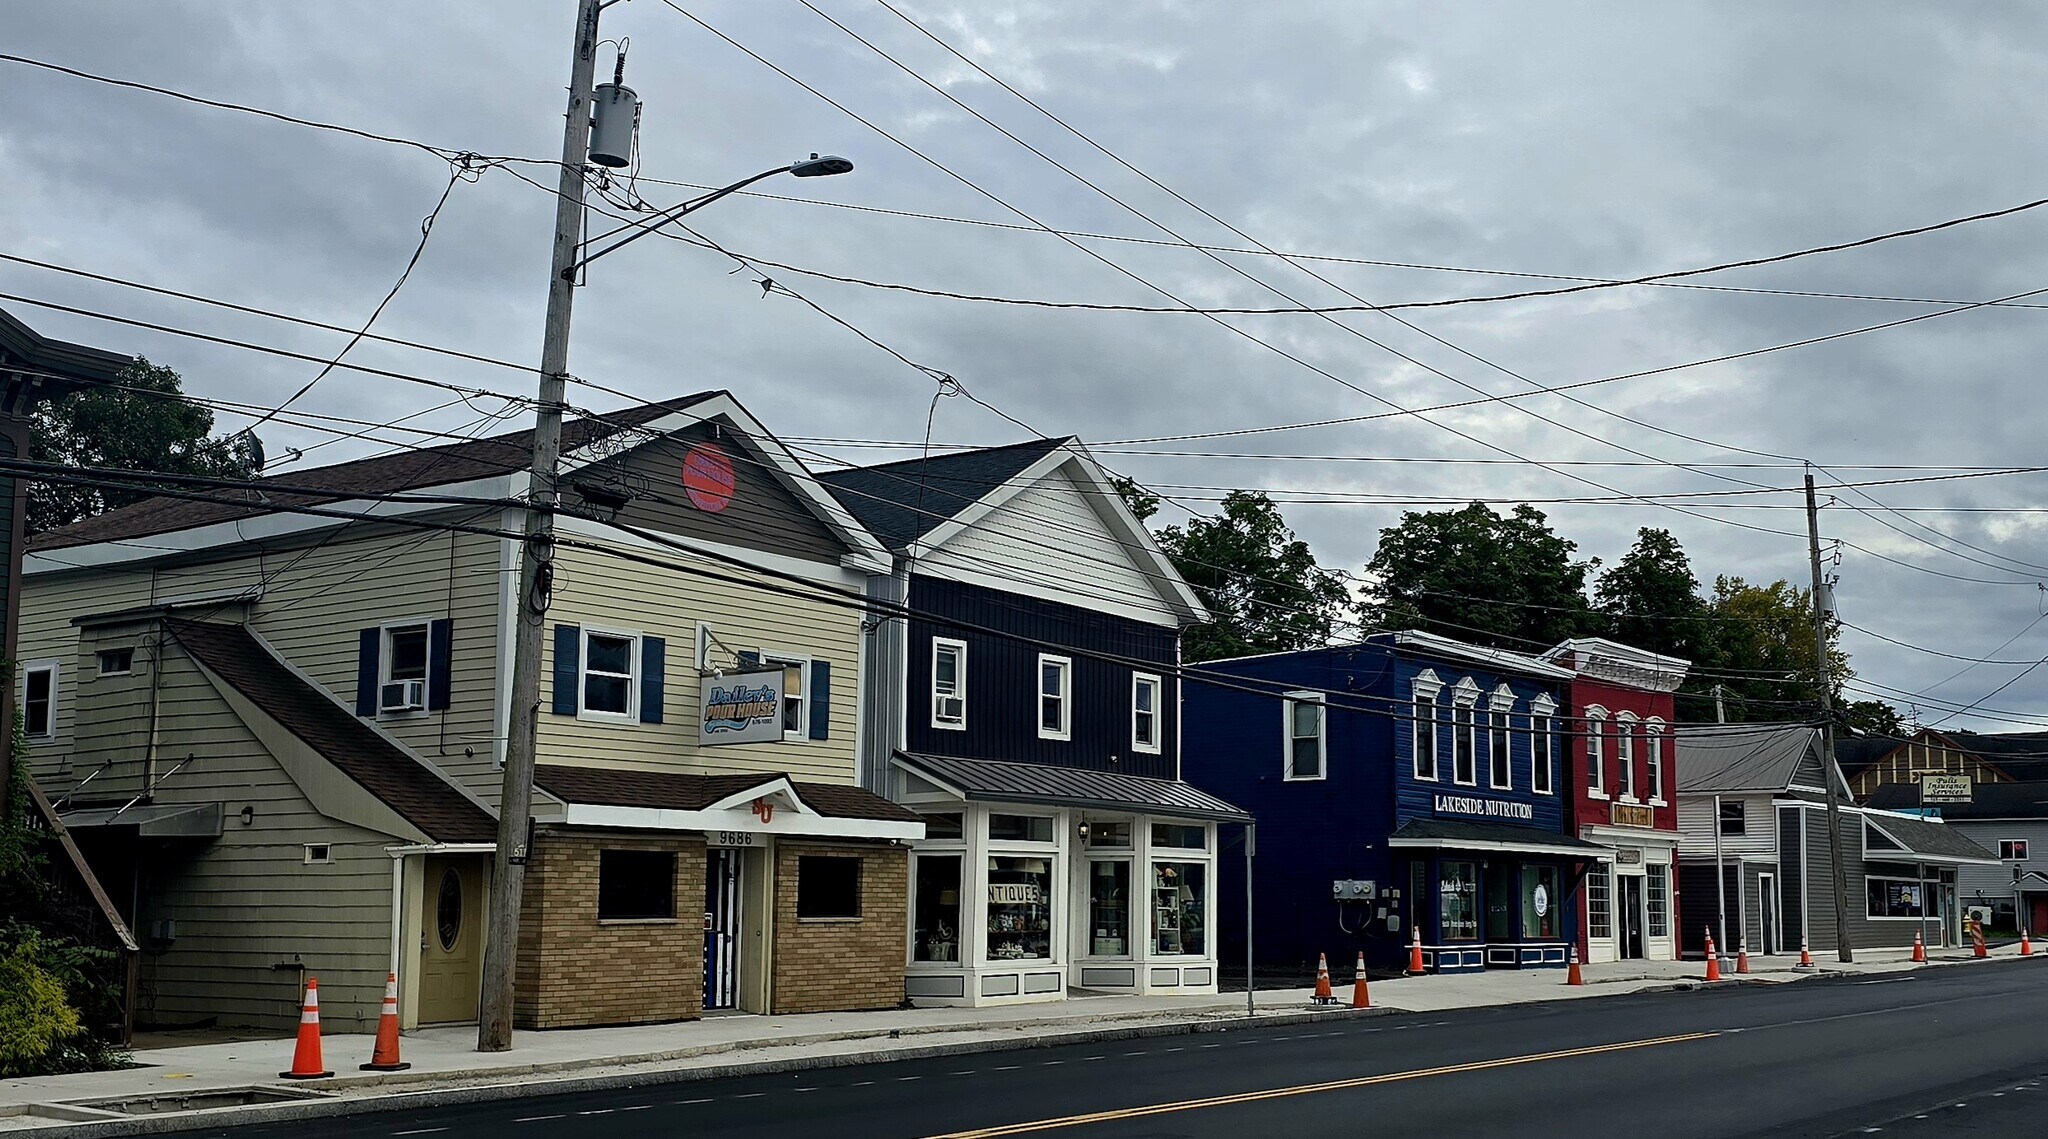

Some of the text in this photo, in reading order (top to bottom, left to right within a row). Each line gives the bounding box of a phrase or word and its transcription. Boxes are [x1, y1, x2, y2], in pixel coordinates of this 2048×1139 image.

[709, 685, 776, 704] Dailey's
[704, 701, 777, 720] POUR HOUSE
[1435, 795, 1533, 819] LAKESIDE NUTRITION
[720, 831, 752, 845] 9686
[988, 885, 1038, 902] NTIQUES
